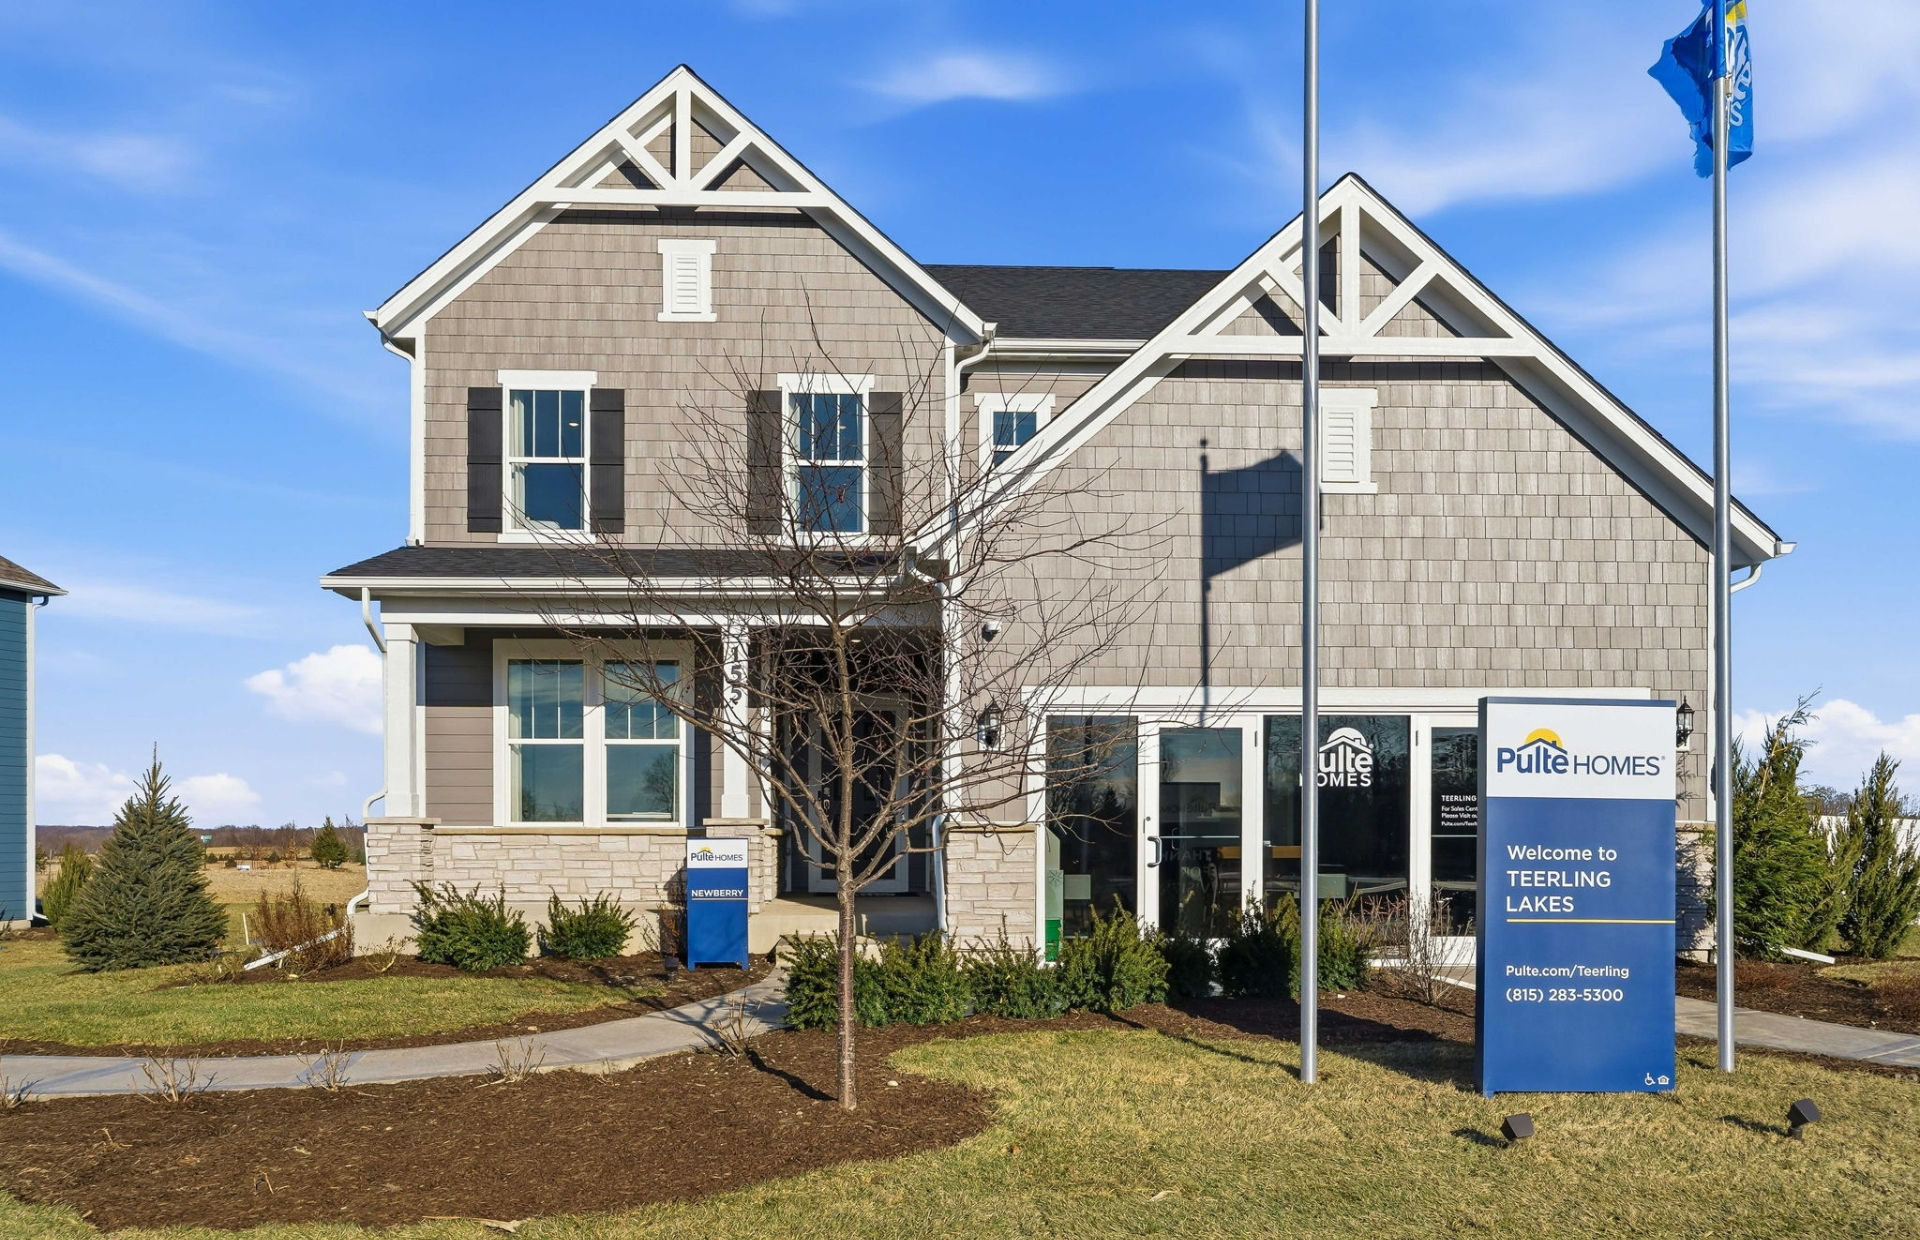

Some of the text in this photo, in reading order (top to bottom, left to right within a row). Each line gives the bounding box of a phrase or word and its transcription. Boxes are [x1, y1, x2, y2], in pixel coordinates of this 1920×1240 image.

[730, 646, 743, 705] 155
[1319, 743, 1374, 773] ulte
[1497, 744, 1660, 776] Pulte HOMES
[691, 852, 714, 861] Pulte
[1507, 845, 1617, 861] Welcome to
[1507, 870, 1611, 887] TEERLING
[691, 889, 743, 897] NEWBERRY
[1506, 895, 1574, 912] LAKES
[1506, 964, 1629, 979] Pulte.com/Teerling
[1506, 988, 1623, 1003] (815) 283-5300
